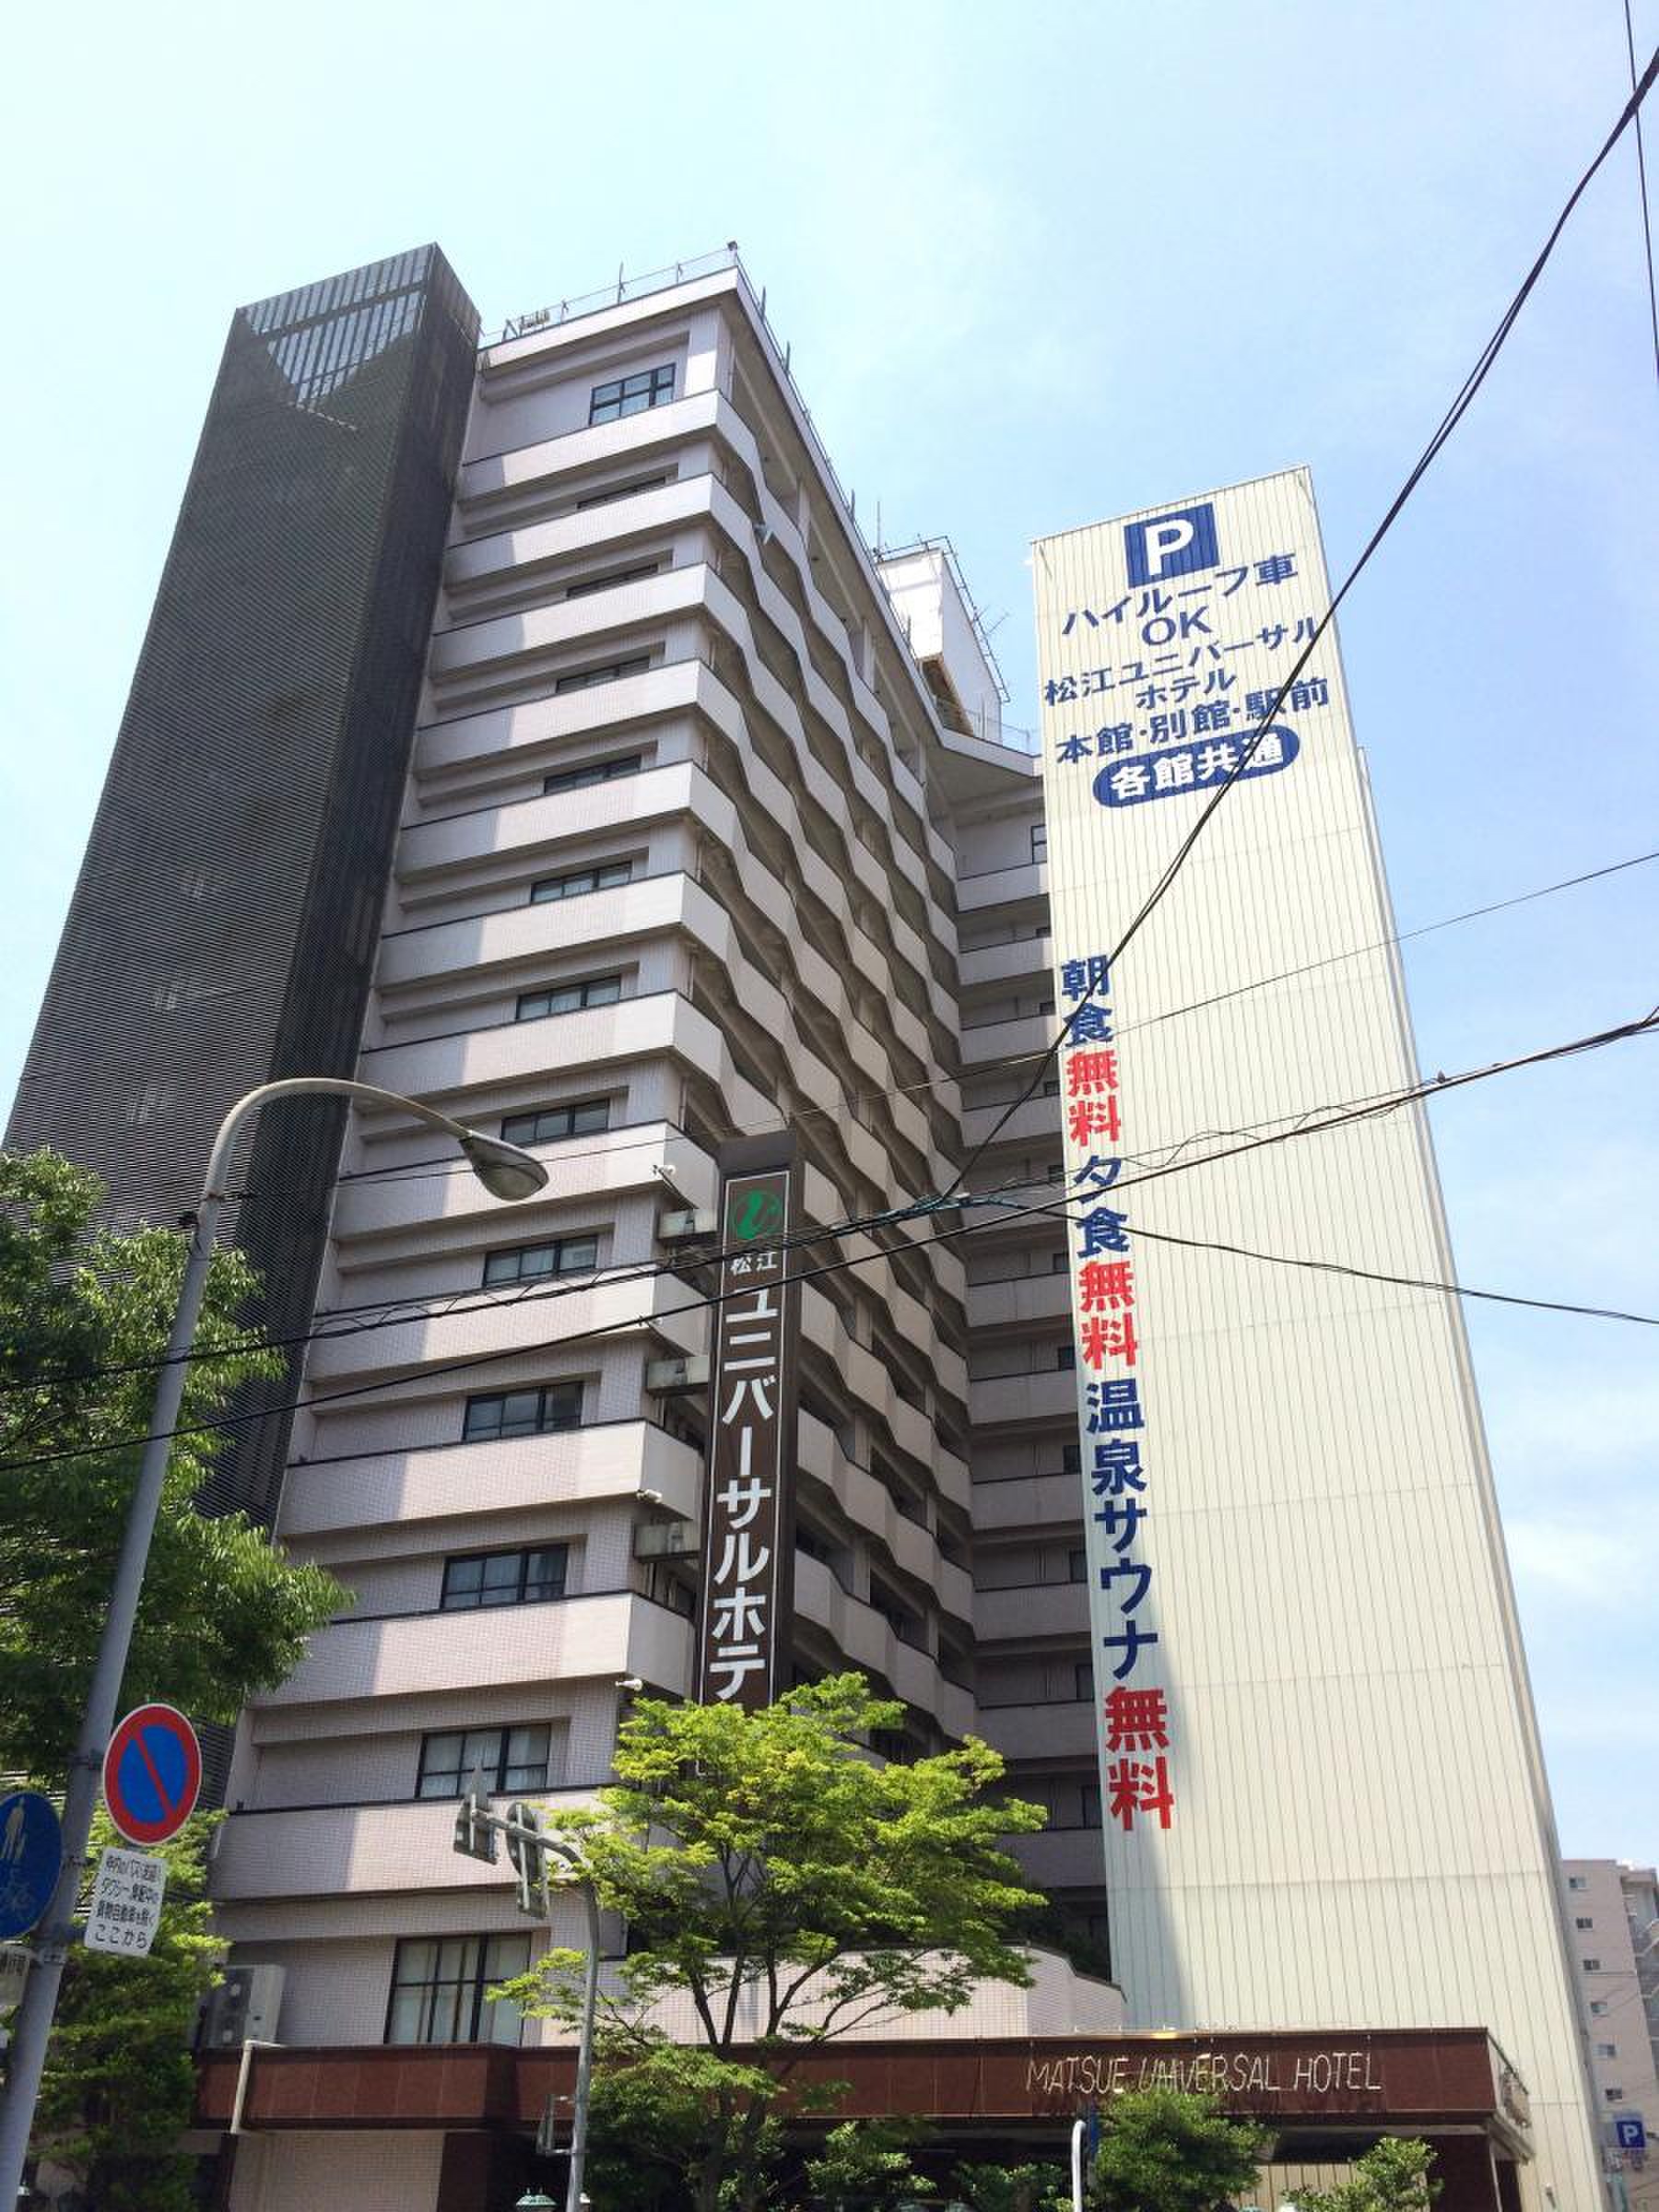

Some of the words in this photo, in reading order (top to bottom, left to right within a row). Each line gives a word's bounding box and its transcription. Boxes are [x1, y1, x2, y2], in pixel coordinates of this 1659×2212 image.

[1144, 518, 1194, 575] P
[1062, 553, 1297, 634] ハイルーフ車
[1141, 606, 1211, 645] OK
[1044, 617, 1316, 707] 松江ユニバーサル
[1135, 667, 1236, 710] ホテル
[730, 1252, 777, 1275] 松江
[710, 1288, 779, 1712] ユニバーサルホテ
[1026, 2055, 1127, 2094] MATSUE
[1292, 2052, 1382, 2092] HOTEL
